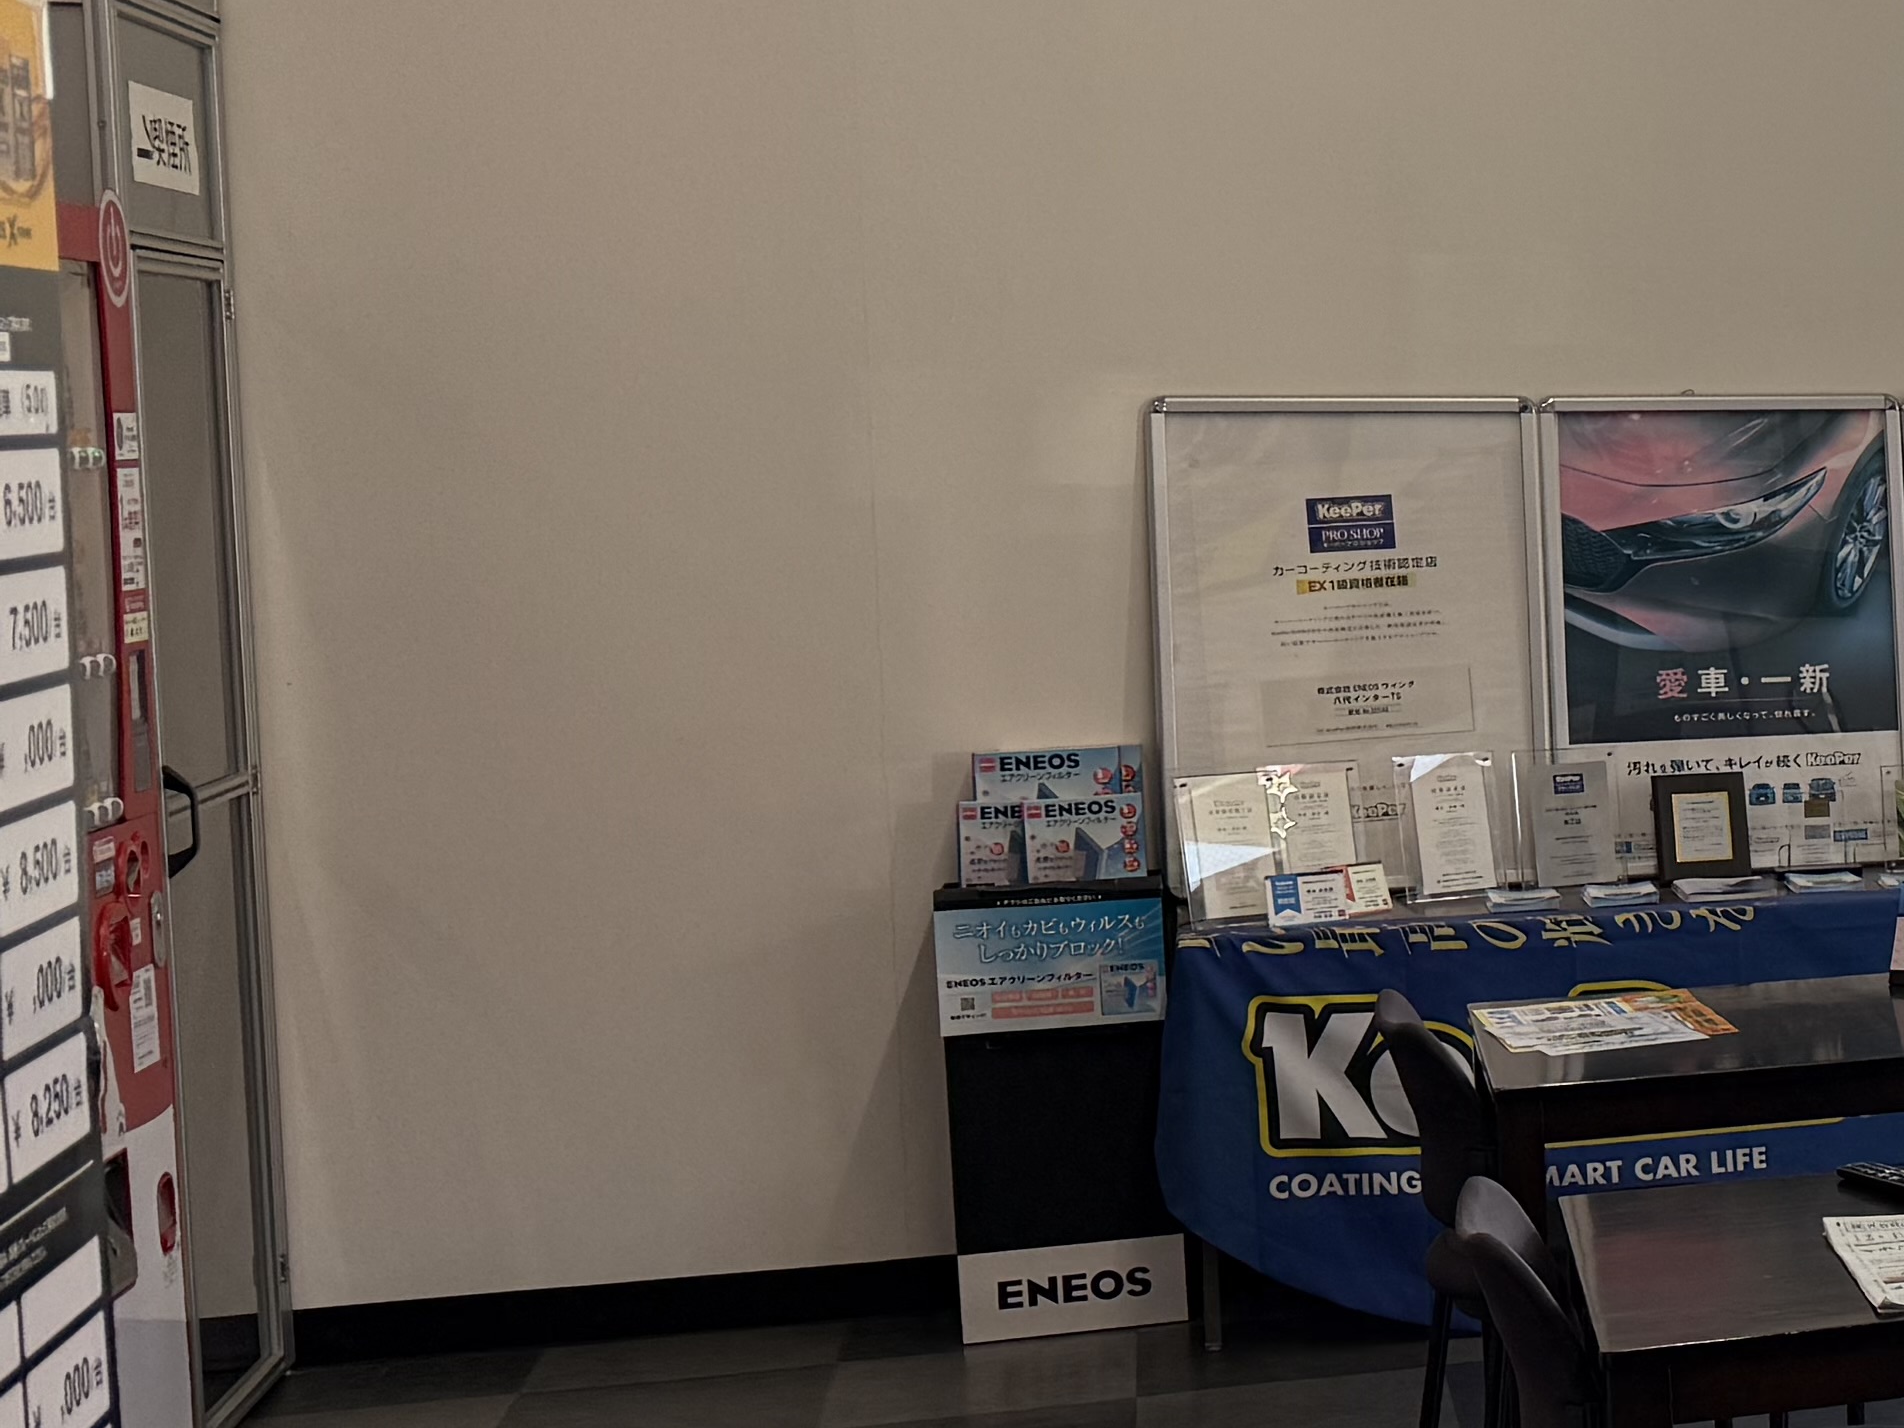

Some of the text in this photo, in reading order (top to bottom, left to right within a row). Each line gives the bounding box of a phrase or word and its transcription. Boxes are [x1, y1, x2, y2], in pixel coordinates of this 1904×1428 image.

[151, 115, 192, 174] 喫煙所
[1316, 500, 1385, 522] KeePer
[1320, 527, 1385, 542] PRO SHOP
[1272, 555, 1438, 578] カーコーティング技術認定店
[1655, 662, 1831, 700] 愛車・一新
[999, 753, 1080, 772] ENEOS
[1044, 799, 1117, 819] ENEOS
[953, 913, 1146, 941] ニオイもカビもウィルスも
[977, 936, 1125, 964] しっかりブロック!
[1269, 1173, 1423, 1201] COATING
[1631, 1155, 1701, 1184] CAR
[1709, 1147, 1769, 1175] LIFE
[997, 1266, 1153, 1312] ENEOS
